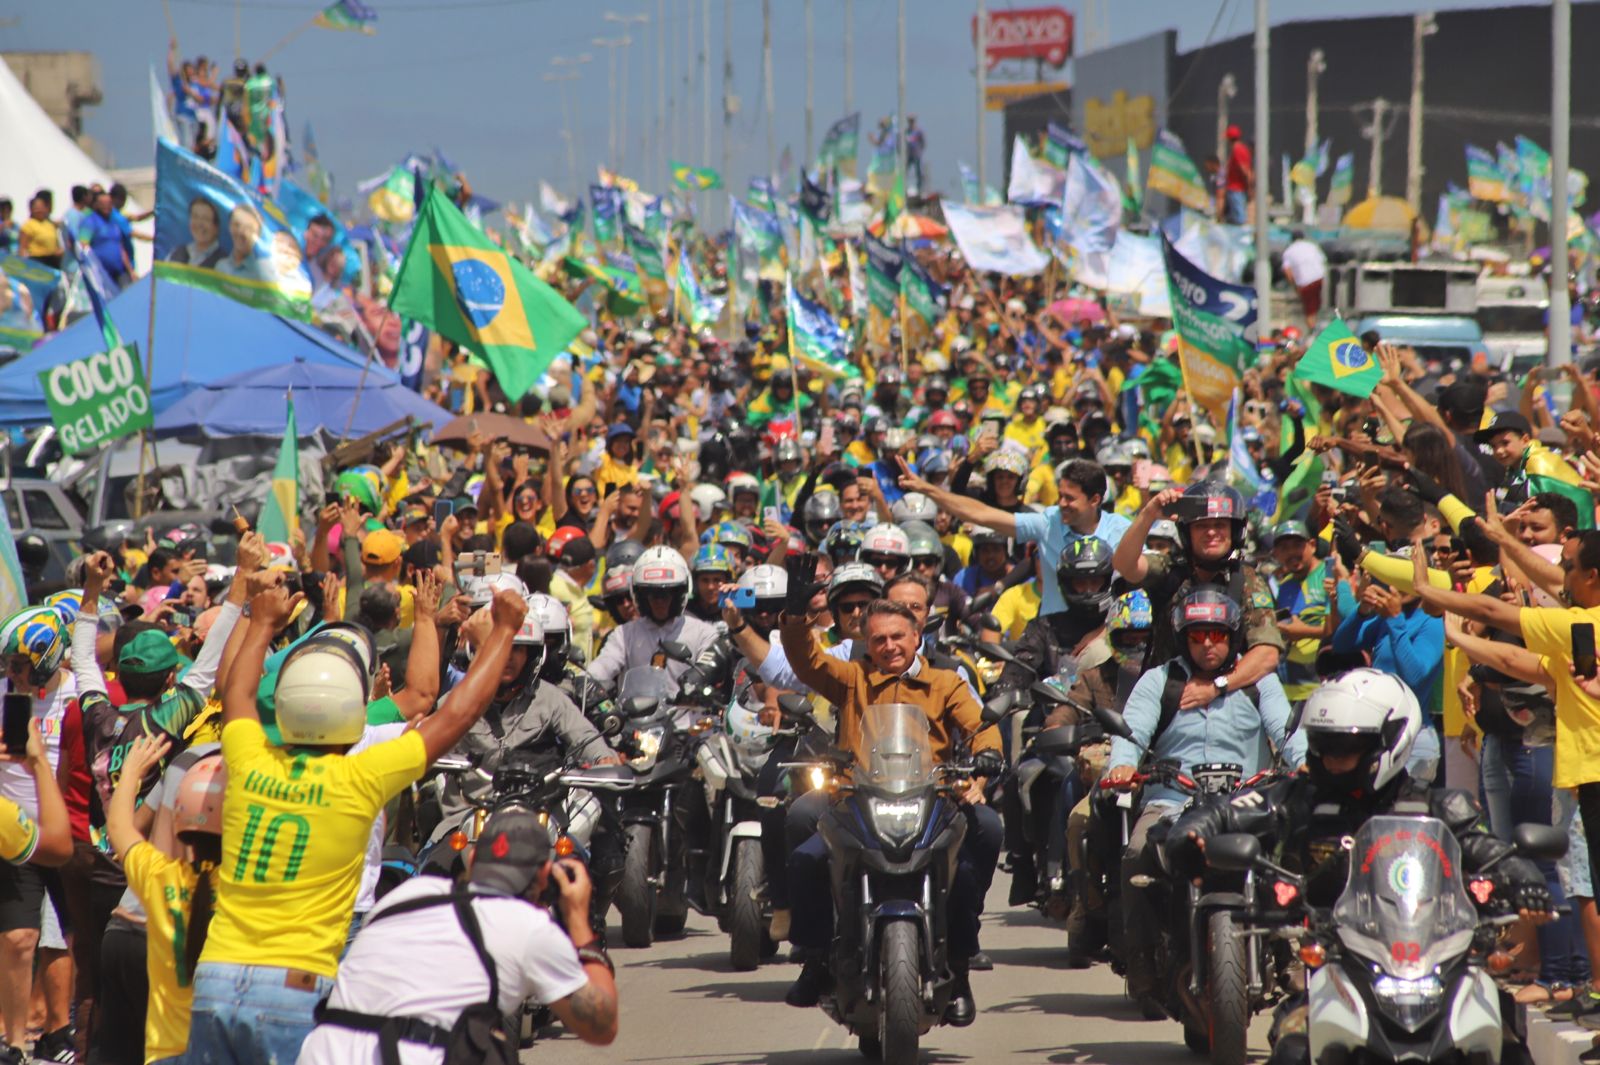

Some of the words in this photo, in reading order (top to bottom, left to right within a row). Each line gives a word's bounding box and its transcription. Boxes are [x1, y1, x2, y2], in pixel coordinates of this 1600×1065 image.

[49, 346, 135, 407] COCO
[60, 384, 149, 452] GELADO
[244, 769, 331, 808] BRASIL
[233, 803, 311, 883] 10
[1391, 941, 1421, 963] 02
